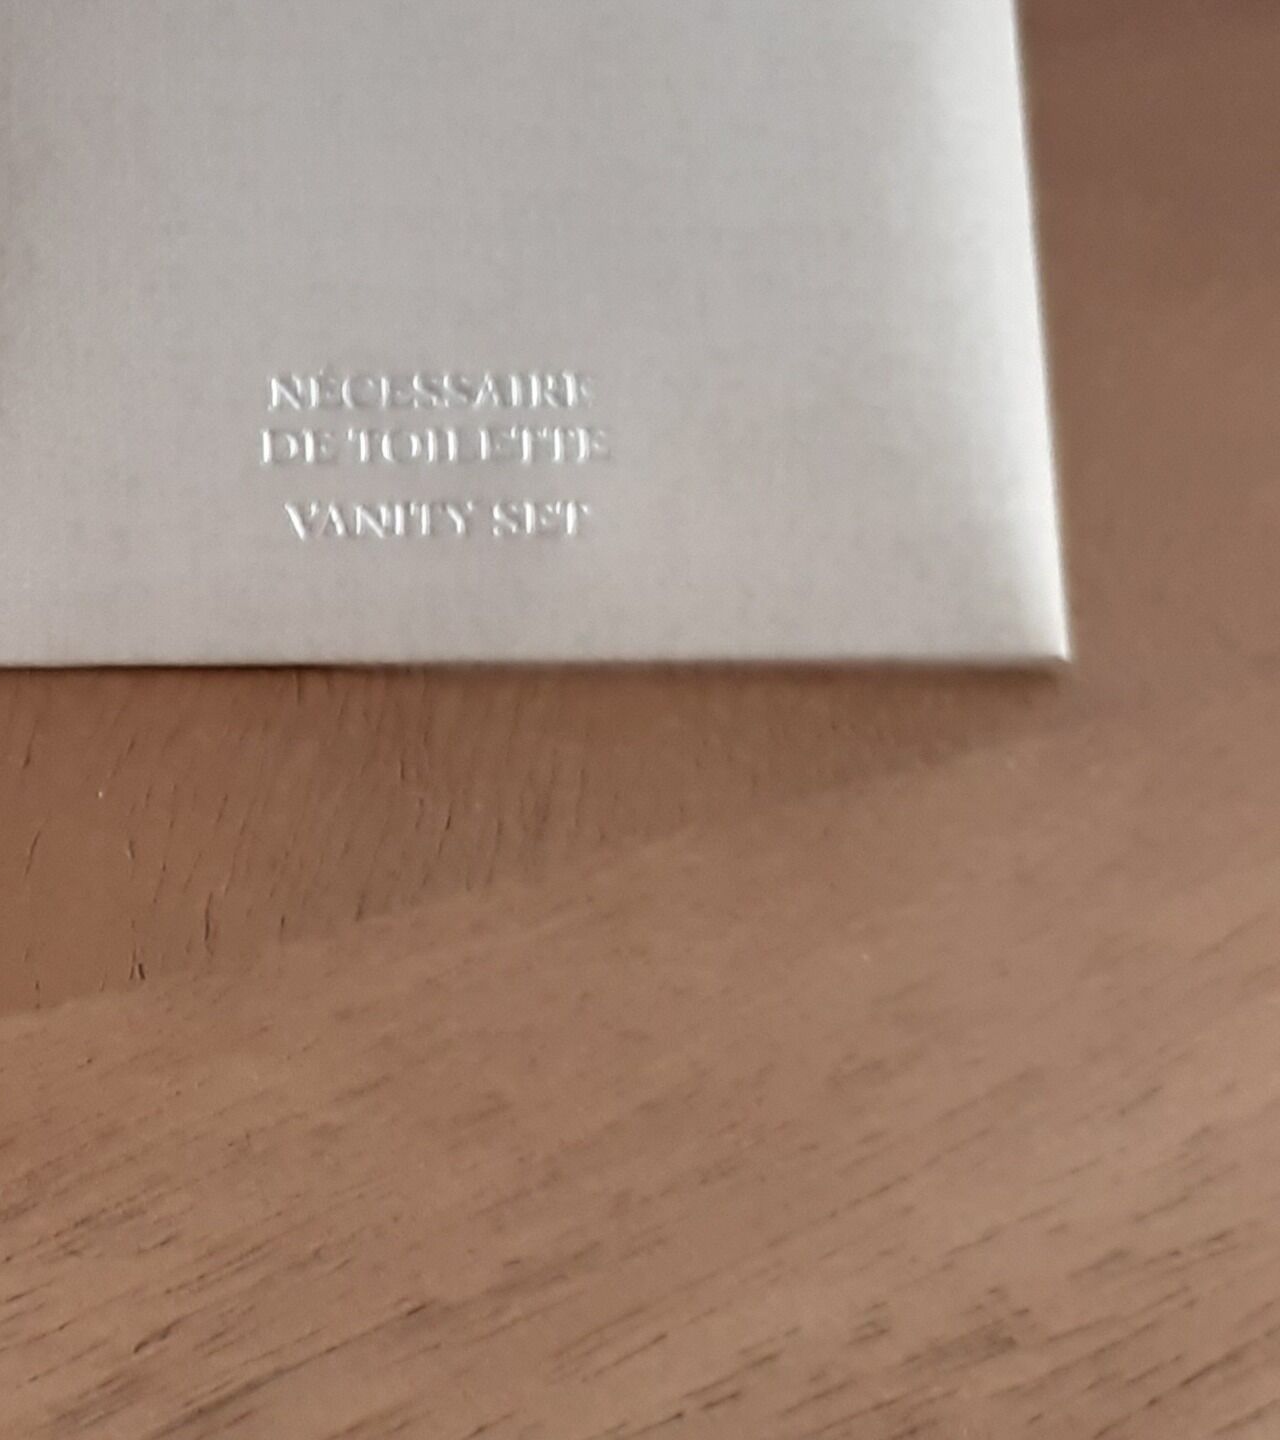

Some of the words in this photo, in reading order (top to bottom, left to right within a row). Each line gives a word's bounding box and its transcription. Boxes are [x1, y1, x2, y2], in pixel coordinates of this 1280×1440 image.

[260, 427, 334, 466] DE
[346, 424, 609, 466] TOILETTE
[284, 499, 475, 541] VANITY
[492, 499, 591, 539] SET
